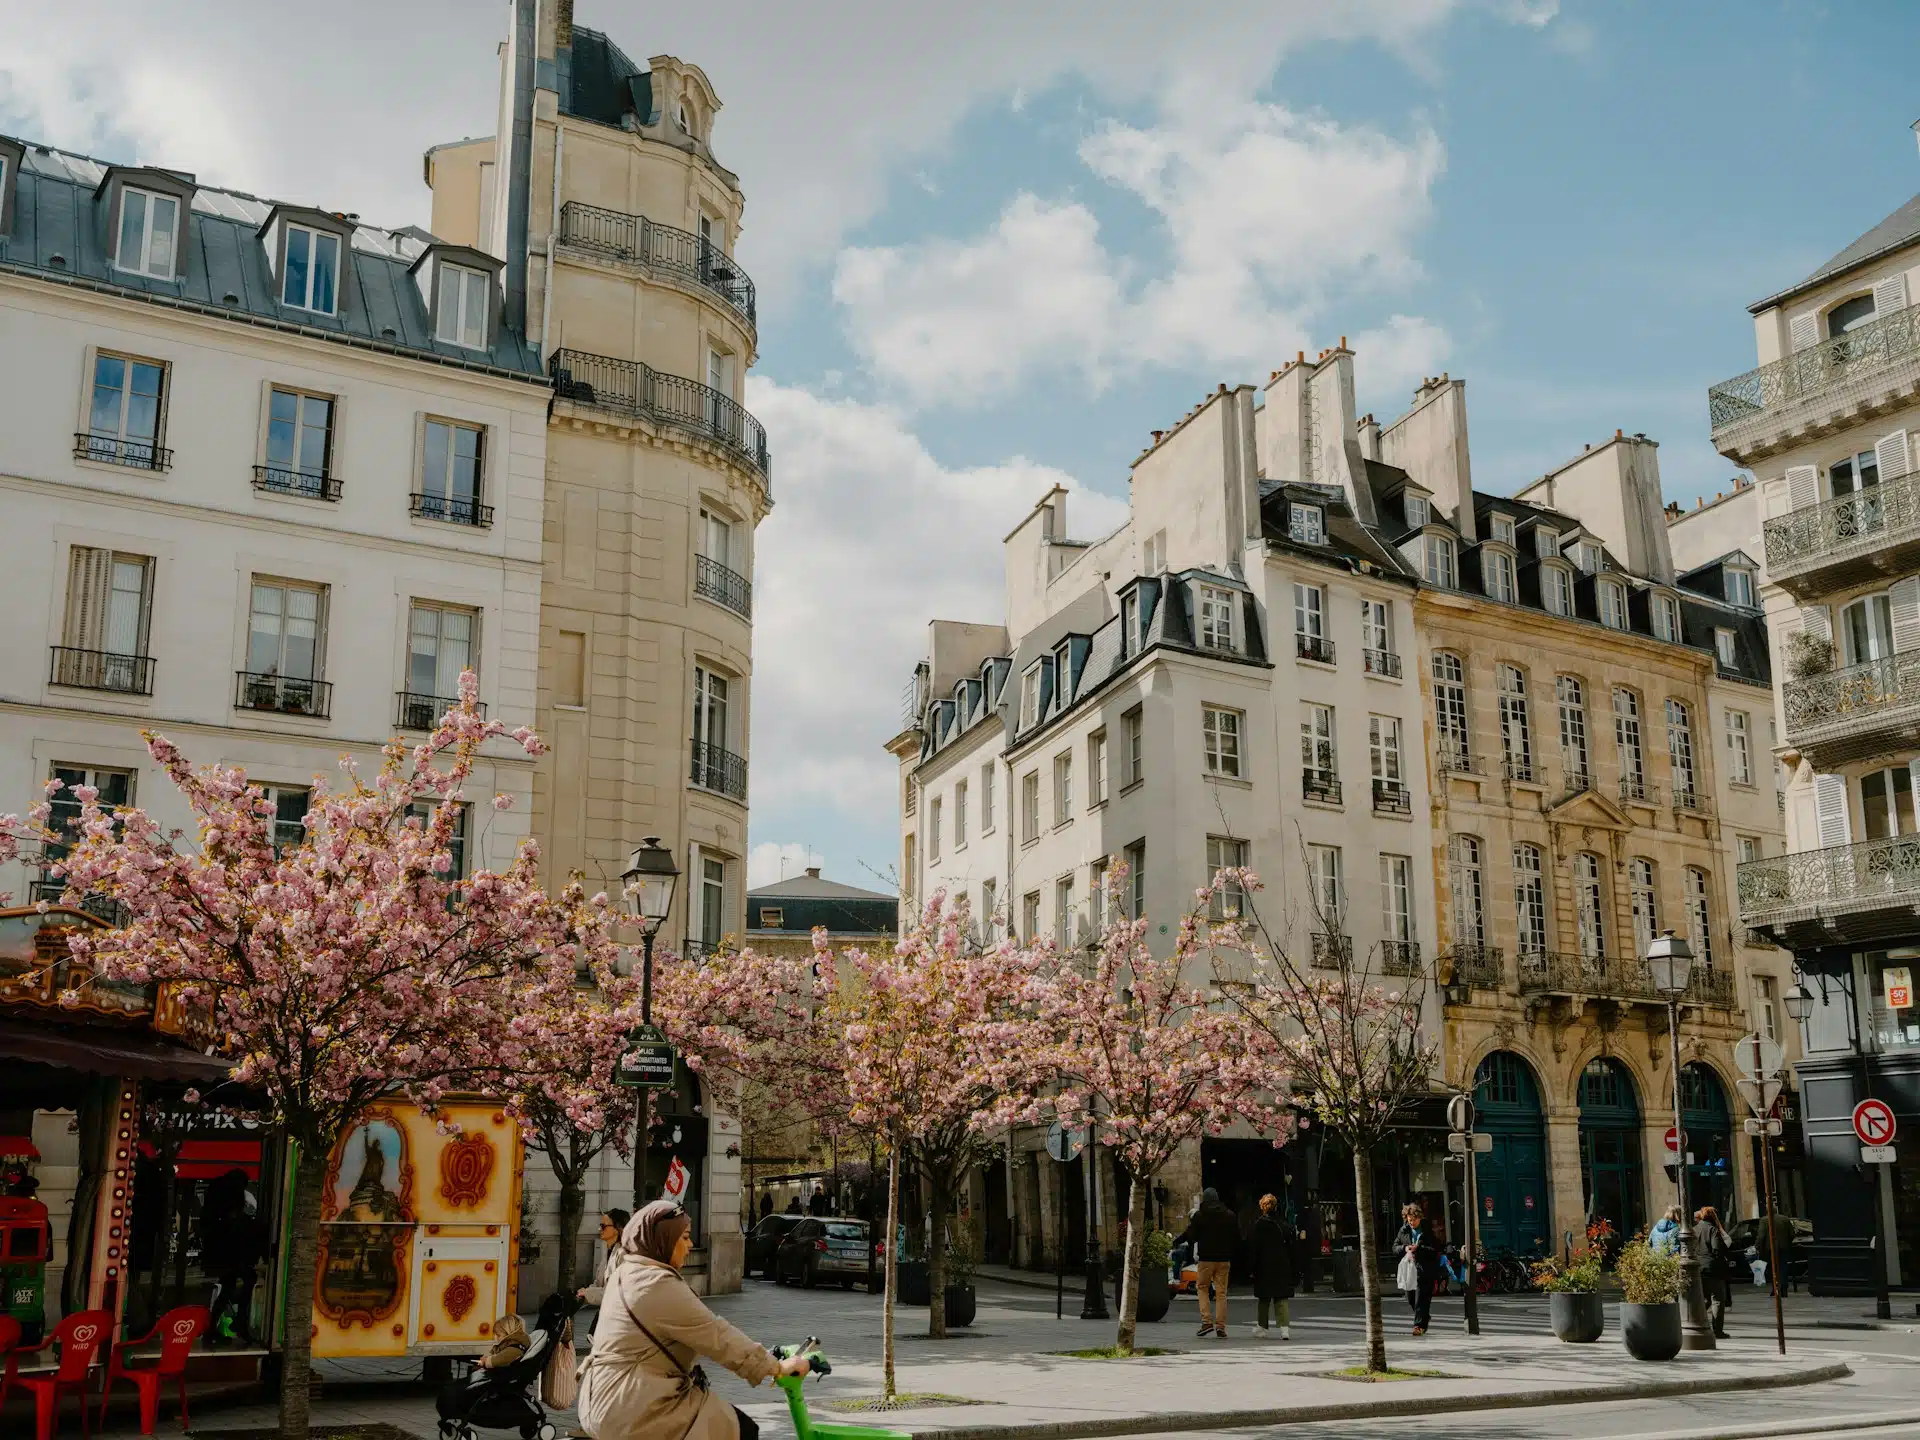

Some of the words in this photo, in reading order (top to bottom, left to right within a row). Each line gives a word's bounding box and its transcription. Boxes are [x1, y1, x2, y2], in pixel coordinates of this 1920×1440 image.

[15, 1289, 34, 1297] ATX
[172, 1336, 188, 1344] MIKO
[72, 1343, 89, 1351] MIKO
